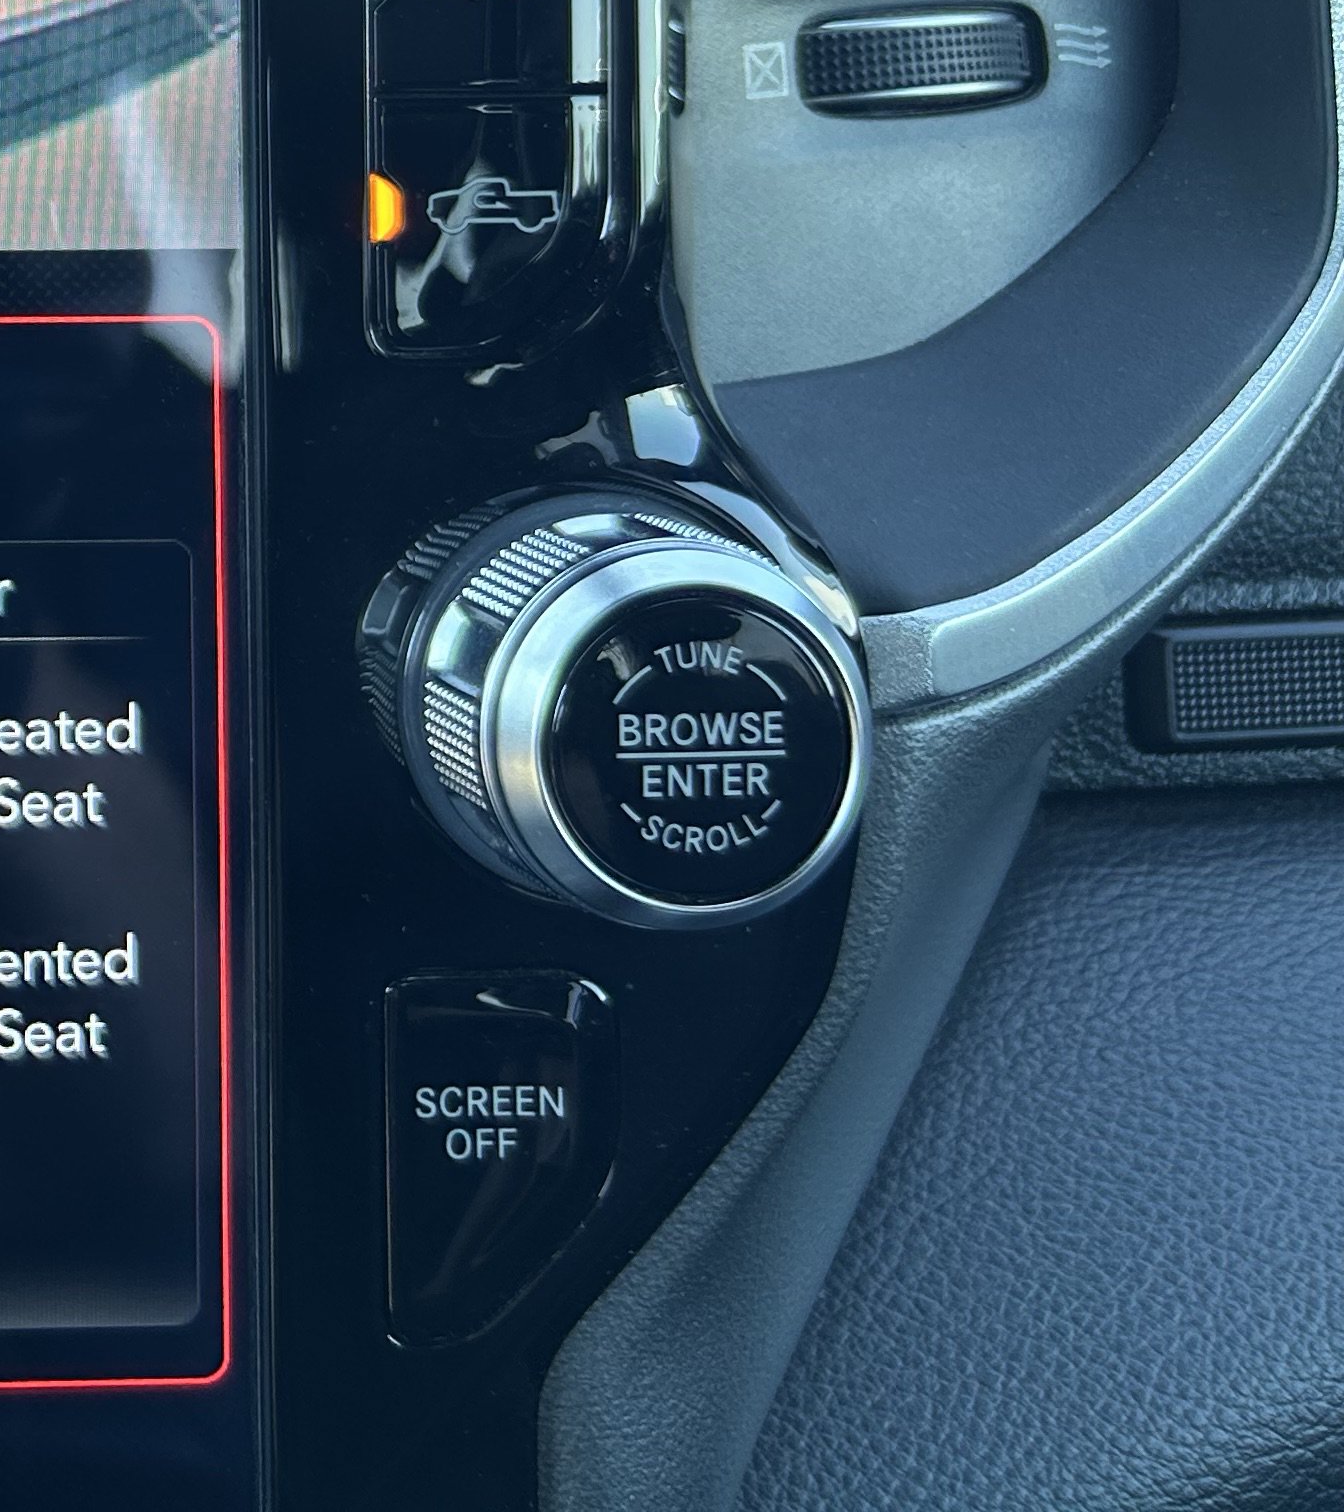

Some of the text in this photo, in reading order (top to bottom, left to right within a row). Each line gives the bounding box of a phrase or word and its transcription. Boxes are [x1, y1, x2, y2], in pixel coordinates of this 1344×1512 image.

[654, 640, 744, 676] TUNE
[616, 710, 785, 747] BROWSE
[641, 764, 771, 798] ENTER
[640, 816, 767, 854] SCROLL
[415, 1087, 565, 1118] SCREEN
[445, 1129, 518, 1160] OFF
